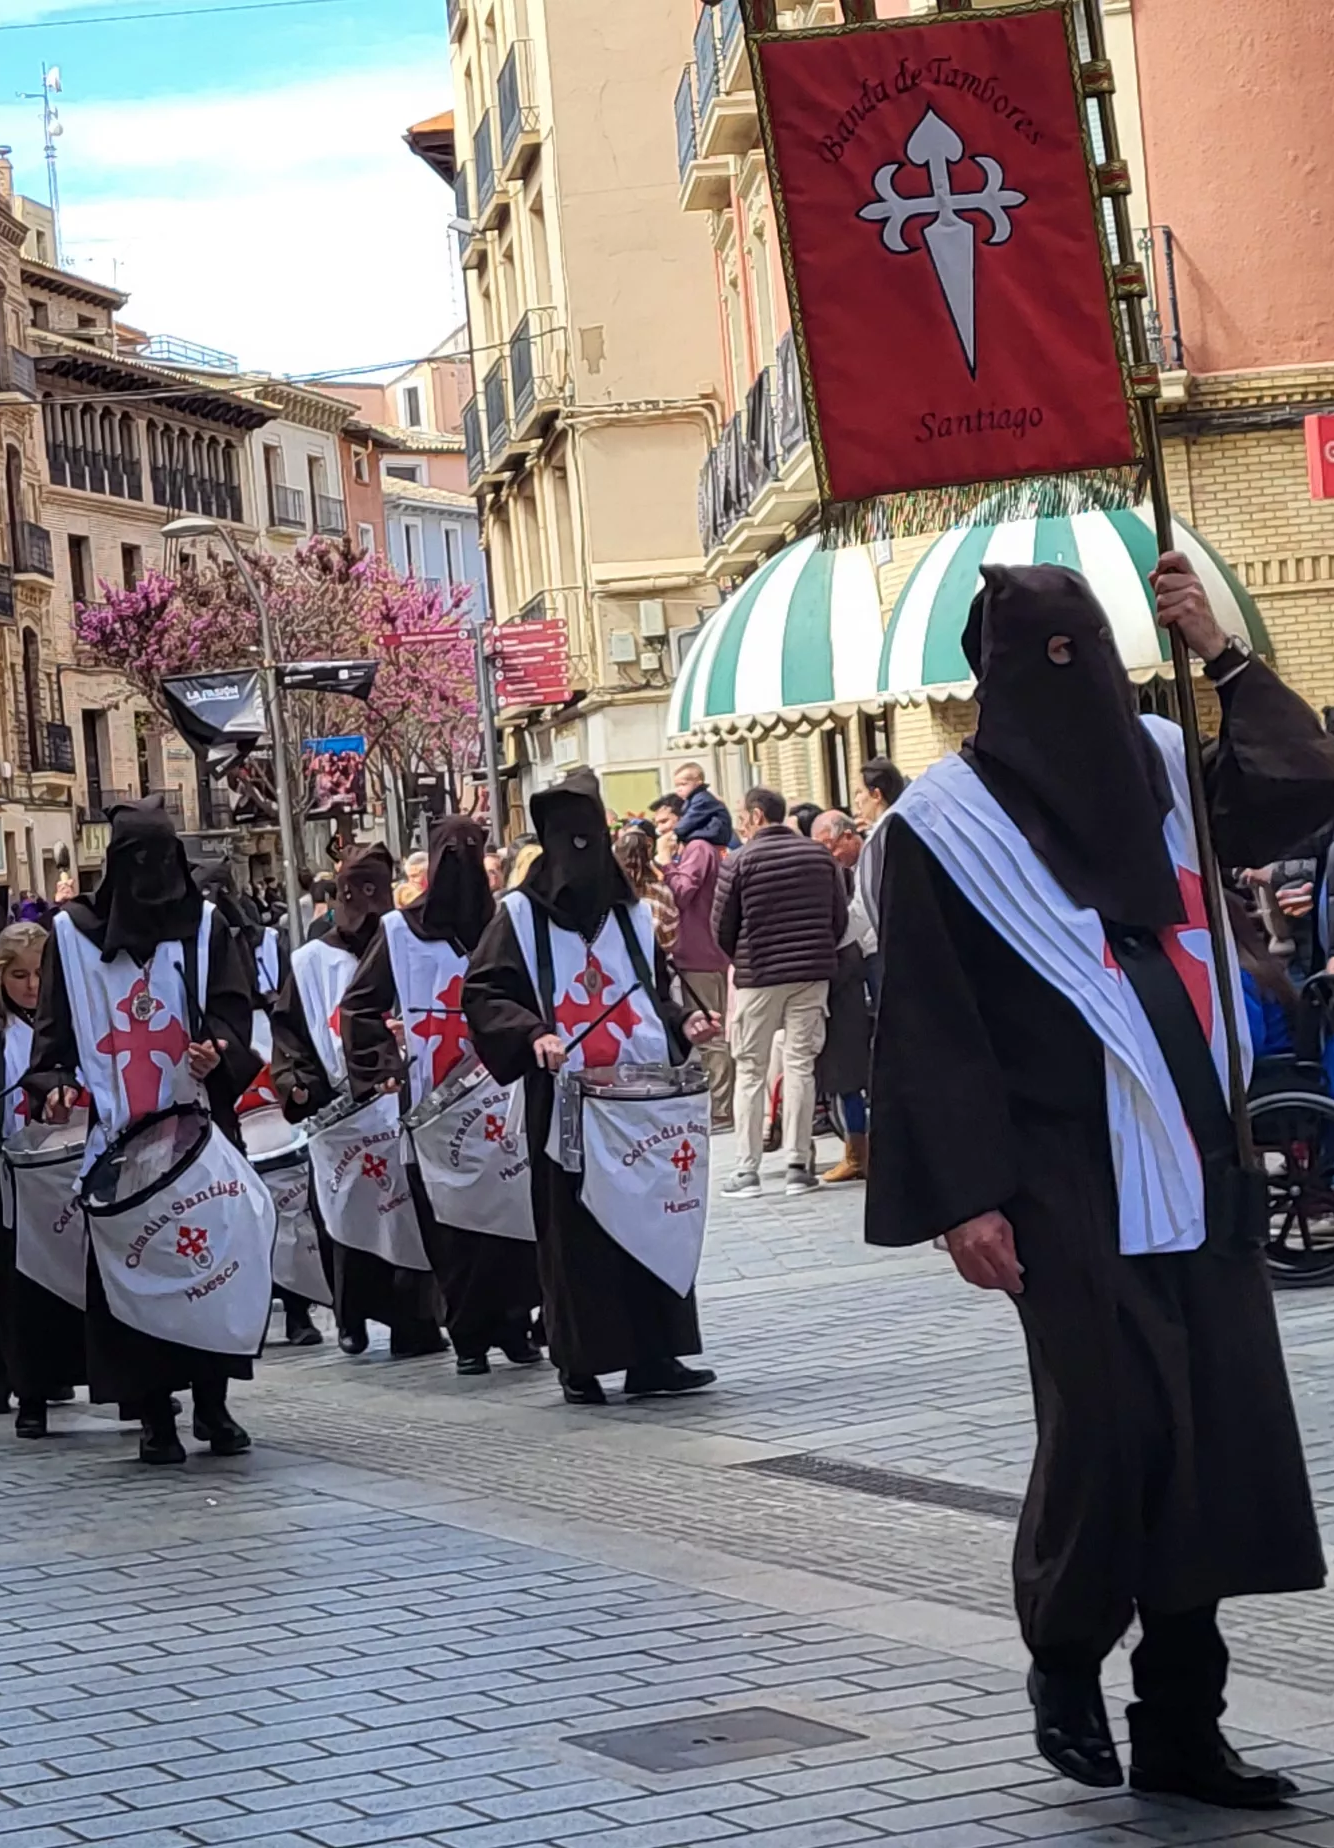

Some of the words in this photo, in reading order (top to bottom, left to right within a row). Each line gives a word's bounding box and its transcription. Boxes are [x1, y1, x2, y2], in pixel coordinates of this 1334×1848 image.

[818, 77, 891, 164] Banda
[893, 56, 924, 94] de
[925, 55, 1044, 146] Tambores
[914, 401, 1044, 444] Santiago
[622, 1124, 686, 1167] Cofradia
[183, 1260, 240, 1304] Huesca
